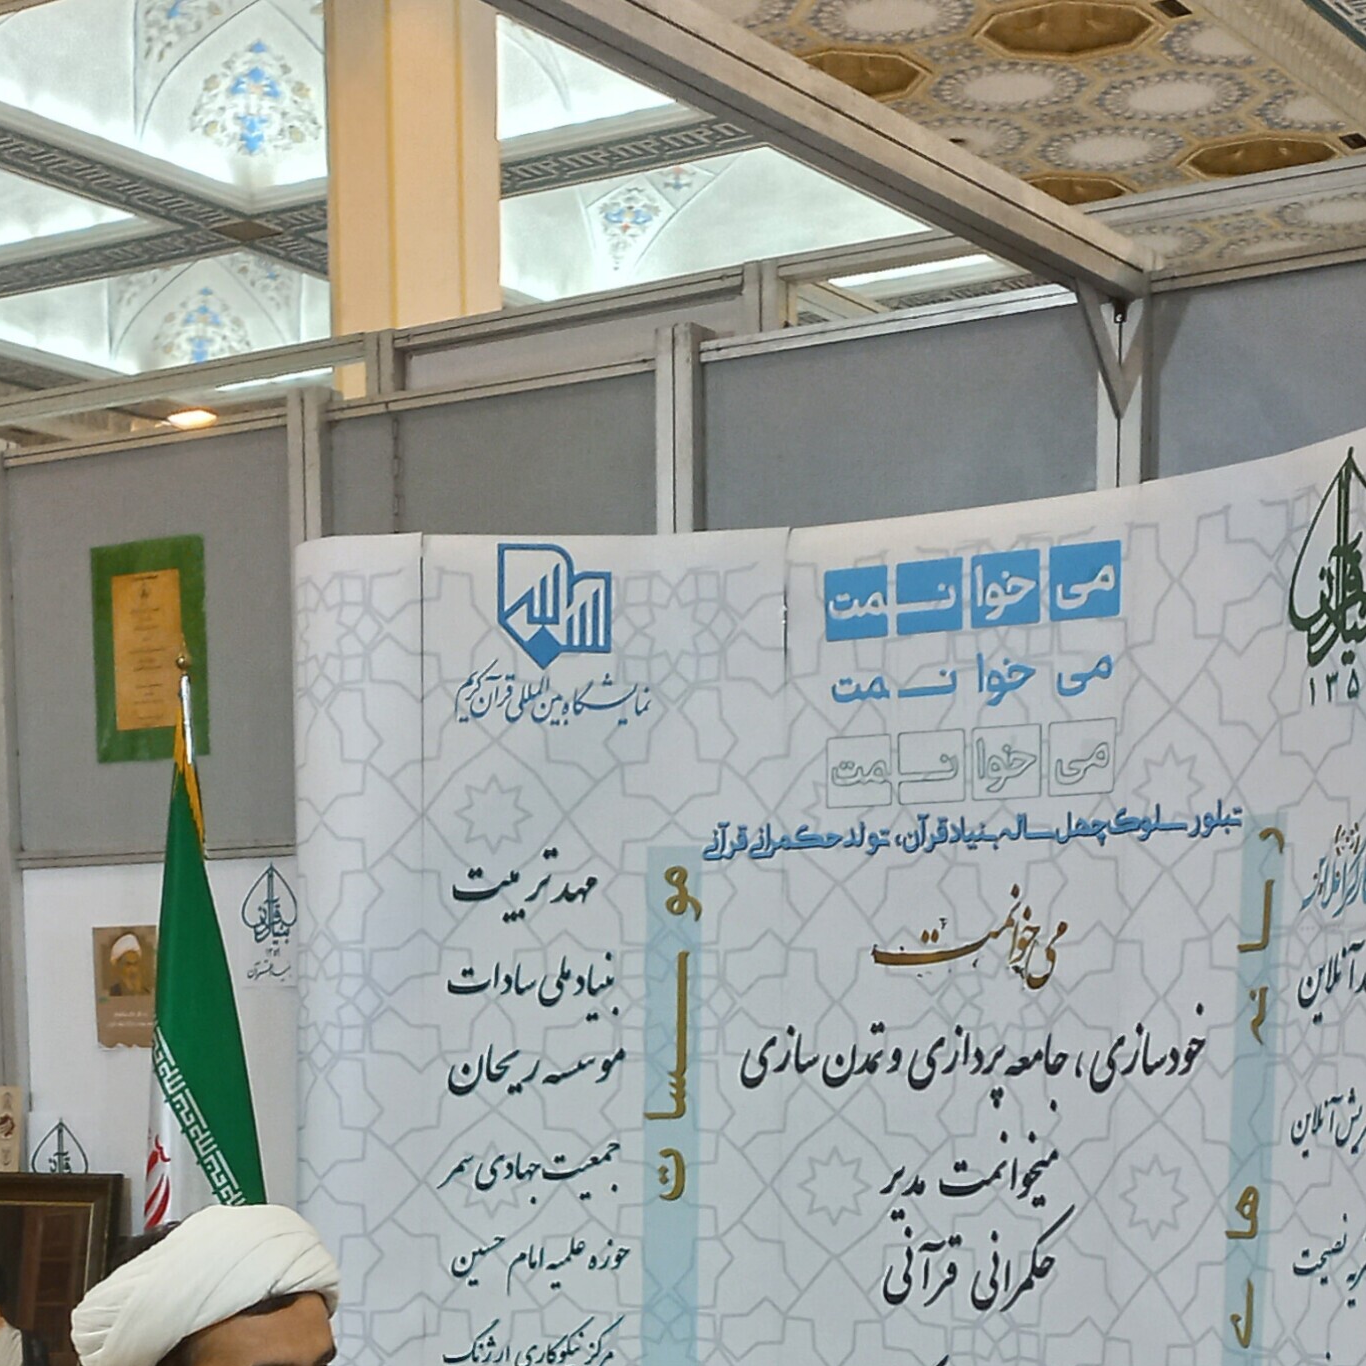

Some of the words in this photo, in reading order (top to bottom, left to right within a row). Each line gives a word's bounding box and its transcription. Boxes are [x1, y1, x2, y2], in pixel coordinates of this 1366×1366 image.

[1055, 558, 1117, 609] می
[563, 673, 652, 726] نمایشگاه
[1057, 654, 1113, 697] می
[1054, 738, 1110, 784] می
[703, 820, 748, 861] قرآنی
[748, 822, 843, 859] حکمرانی
[842, 821, 890, 855] تولد
[949, 814, 998, 850] بنیاد
[999, 812, 1055, 842] ساله
[1056, 811, 1108, 847] چهل
[1108, 803, 1187, 842] سلوک
[1187, 799, 1243, 838] تبلور
[451, 847, 559, 924] تربیت
[550, 875, 599, 904] مهد
[447, 961, 537, 996] سادات
[537, 955, 571, 1007] ملی
[572, 951, 621, 1022] بنیاد
[447, 1043, 541, 1096] ریحان
[542, 1048, 627, 1085] موسسه
[740, 1024, 820, 1090] سازی
[821, 1021, 886, 1088] تمدن
[886, 1046, 903, 1076] و
[906, 1024, 1008, 1111] پردازی
[1003, 1034, 1070, 1112] جامعه
[474, 1152, 542, 1205] جهادی
[540, 1141, 622, 1202] جمعیت
[879, 1164, 927, 1222] مدیر
[450, 1234, 507, 1287] حسین
[506, 1244, 545, 1297] امام
[545, 1237, 587, 1290] علمیه
[587, 1239, 632, 1271] حوزه
[882, 1225, 963, 1308] قرآنی
[970, 1204, 1076, 1313] حکمرانی
